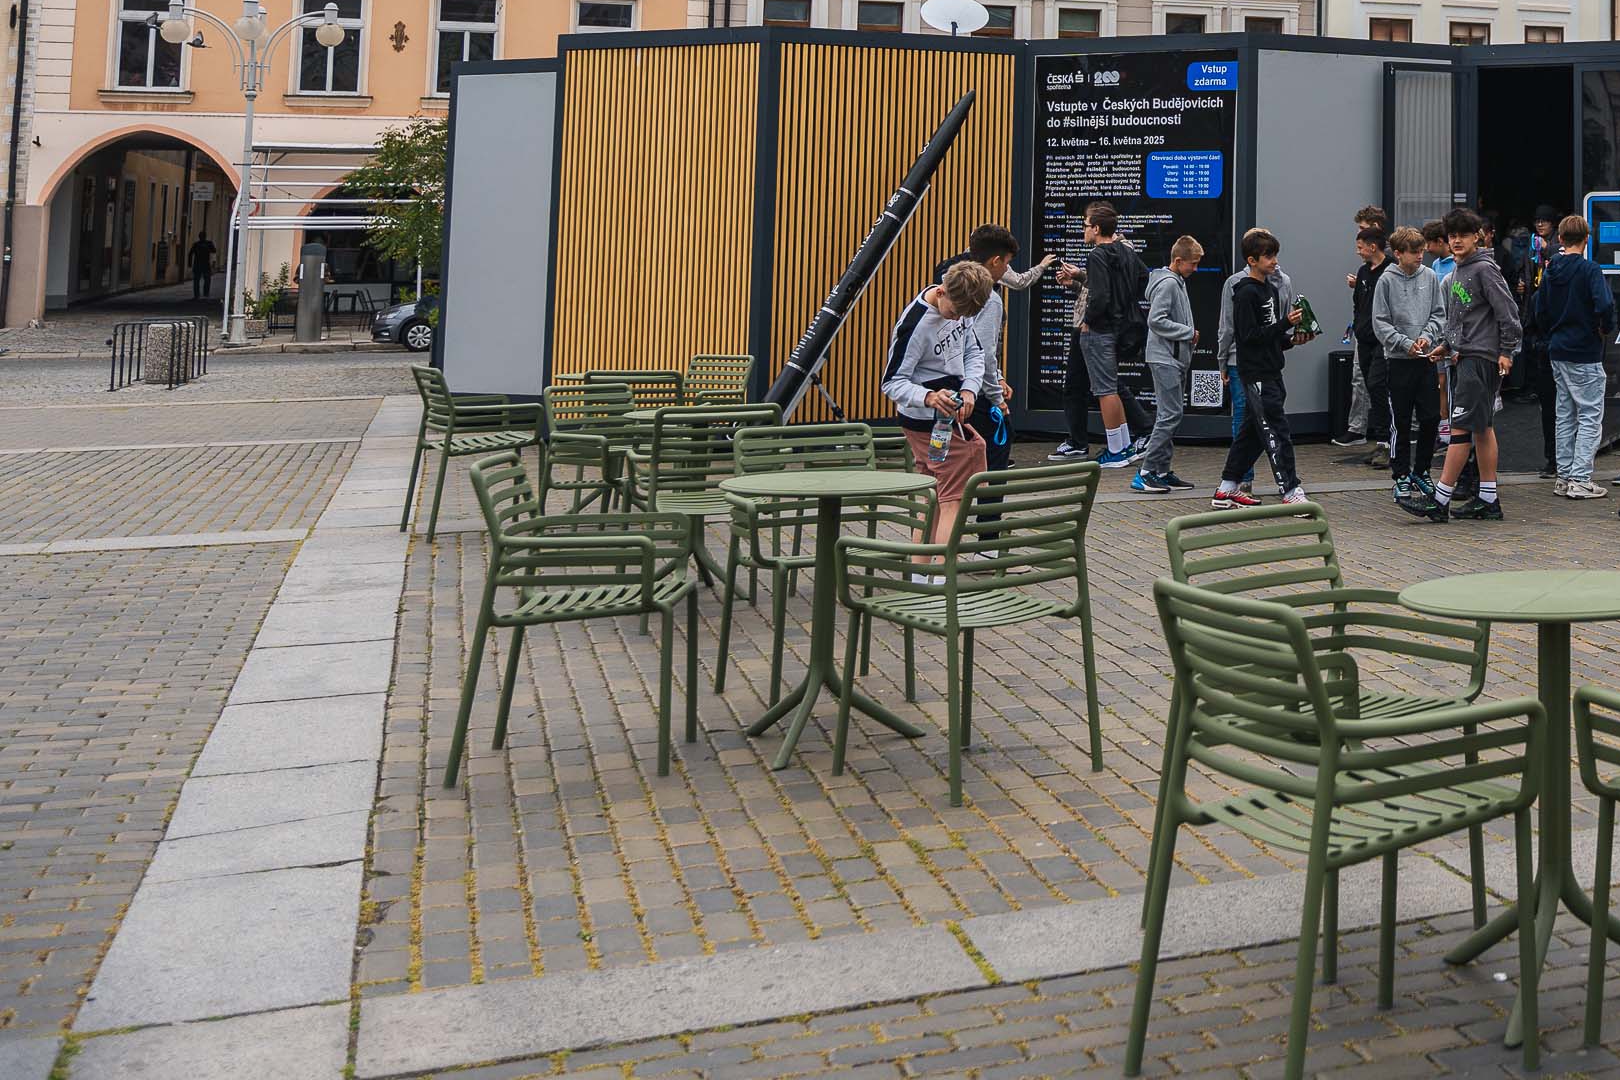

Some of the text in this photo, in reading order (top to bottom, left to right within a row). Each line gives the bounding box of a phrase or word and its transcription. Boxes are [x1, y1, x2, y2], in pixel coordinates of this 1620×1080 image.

[1202, 64, 1227, 74] Vstup
[1047, 73, 1073, 83] ČESKÁ
[1194, 78, 1226, 86] zdarma
[1047, 97, 1223, 113] Vstupte v Českých Budějovicích
[1047, 114, 1181, 129] do #silnější budoucnosti
[1046, 138, 1059, 146] 12.
[1061, 138, 1088, 146] května
[1099, 137, 1110, 146] 16.
[1113, 136, 1141, 145] května
[1144, 136, 1164, 144] 2025
